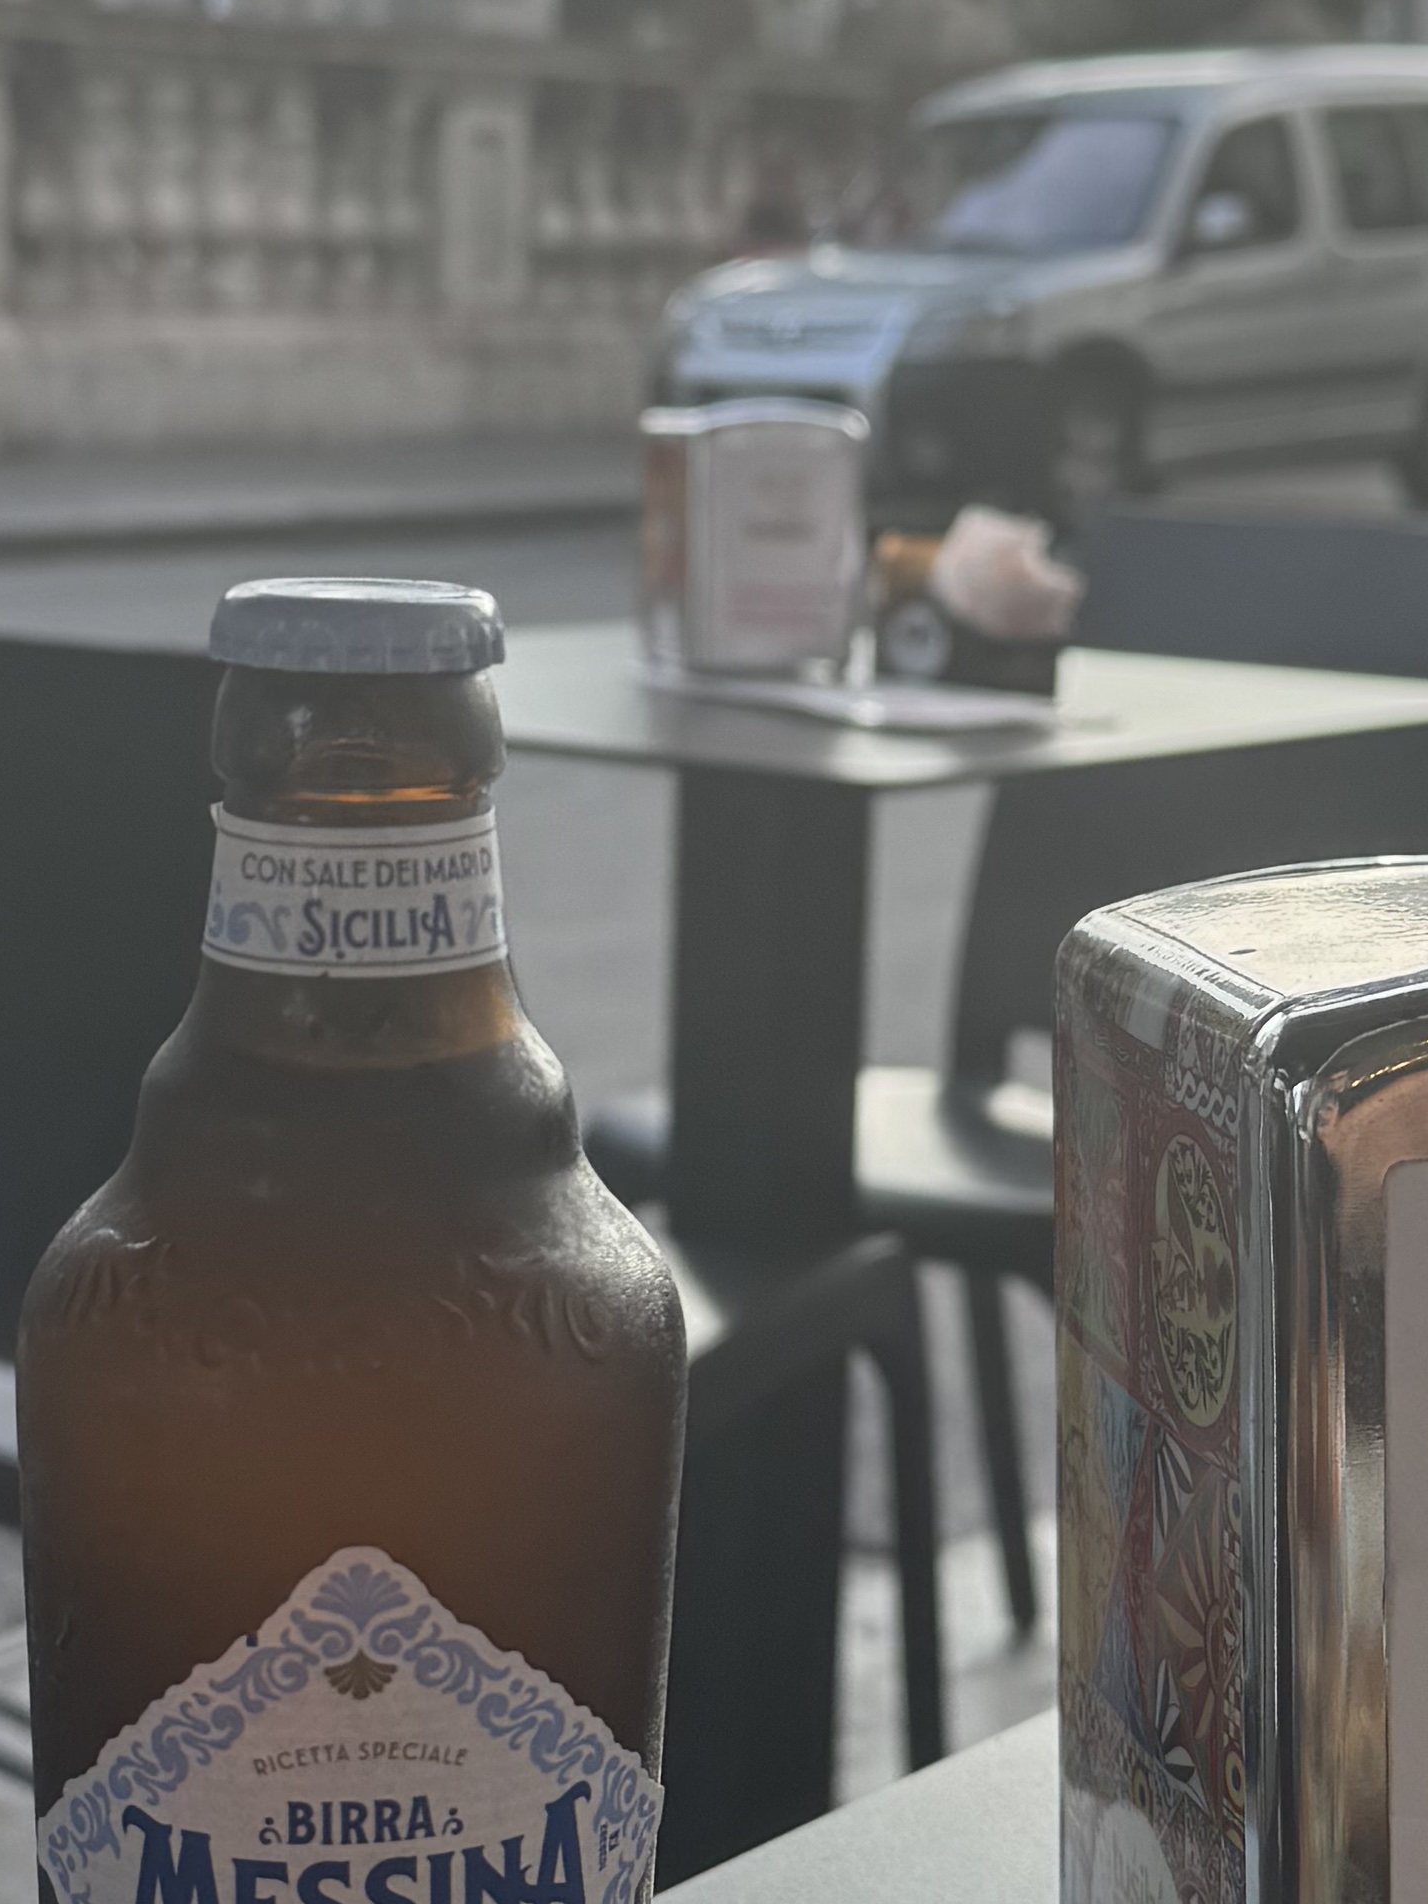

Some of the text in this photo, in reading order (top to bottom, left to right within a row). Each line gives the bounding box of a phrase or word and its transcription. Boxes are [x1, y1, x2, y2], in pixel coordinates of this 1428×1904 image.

[241, 851, 296, 886] CON
[301, 858, 368, 888] SALE
[374, 859, 419, 887] DEI
[425, 851, 478, 884] MARI
[297, 893, 456, 959] SICILIA
[253, 1741, 469, 1776] RICETTA SPECIALE
[287, 1795, 436, 1845] BIRRA
